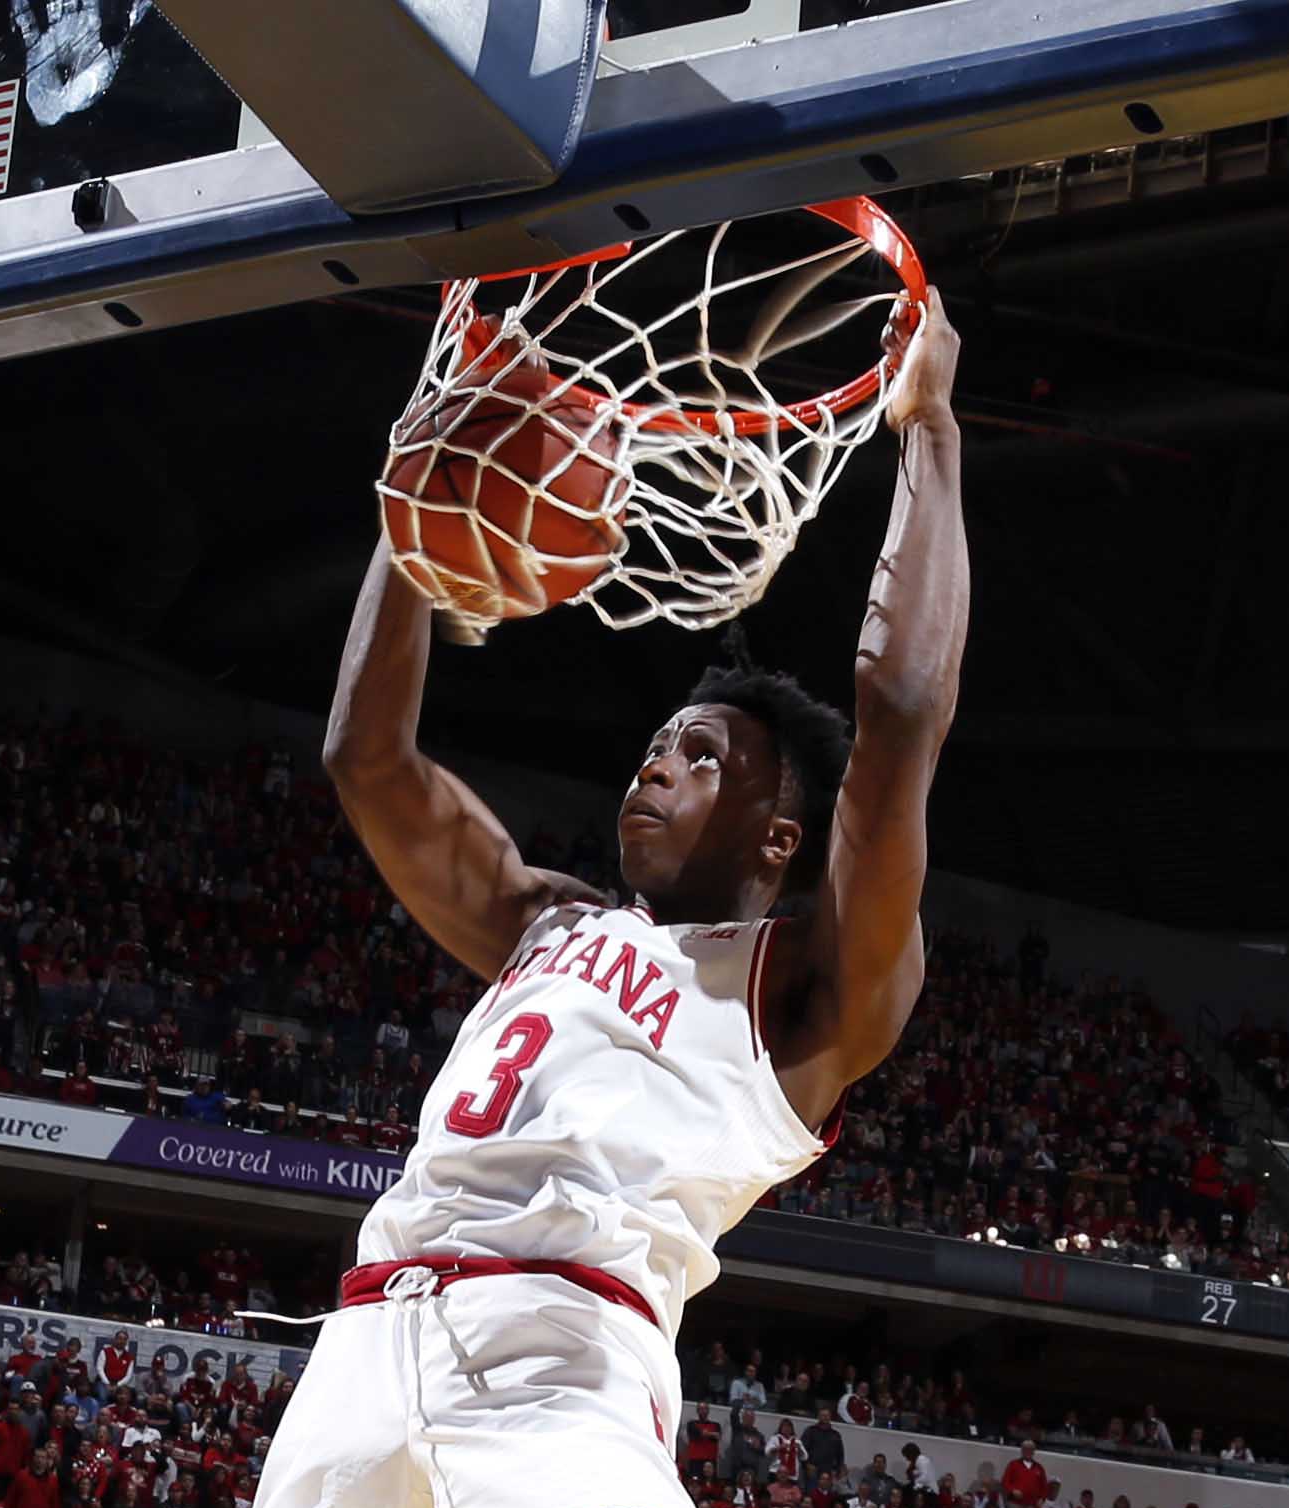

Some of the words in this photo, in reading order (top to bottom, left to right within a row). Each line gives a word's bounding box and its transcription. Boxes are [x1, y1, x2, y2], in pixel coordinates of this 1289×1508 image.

[445, 1012, 554, 1140] 3
[160, 1136, 271, 1175] Covered
[279, 1160, 318, 1183] with
[1204, 1281, 1233, 1297] REB
[1200, 1297, 1237, 1326] 27
